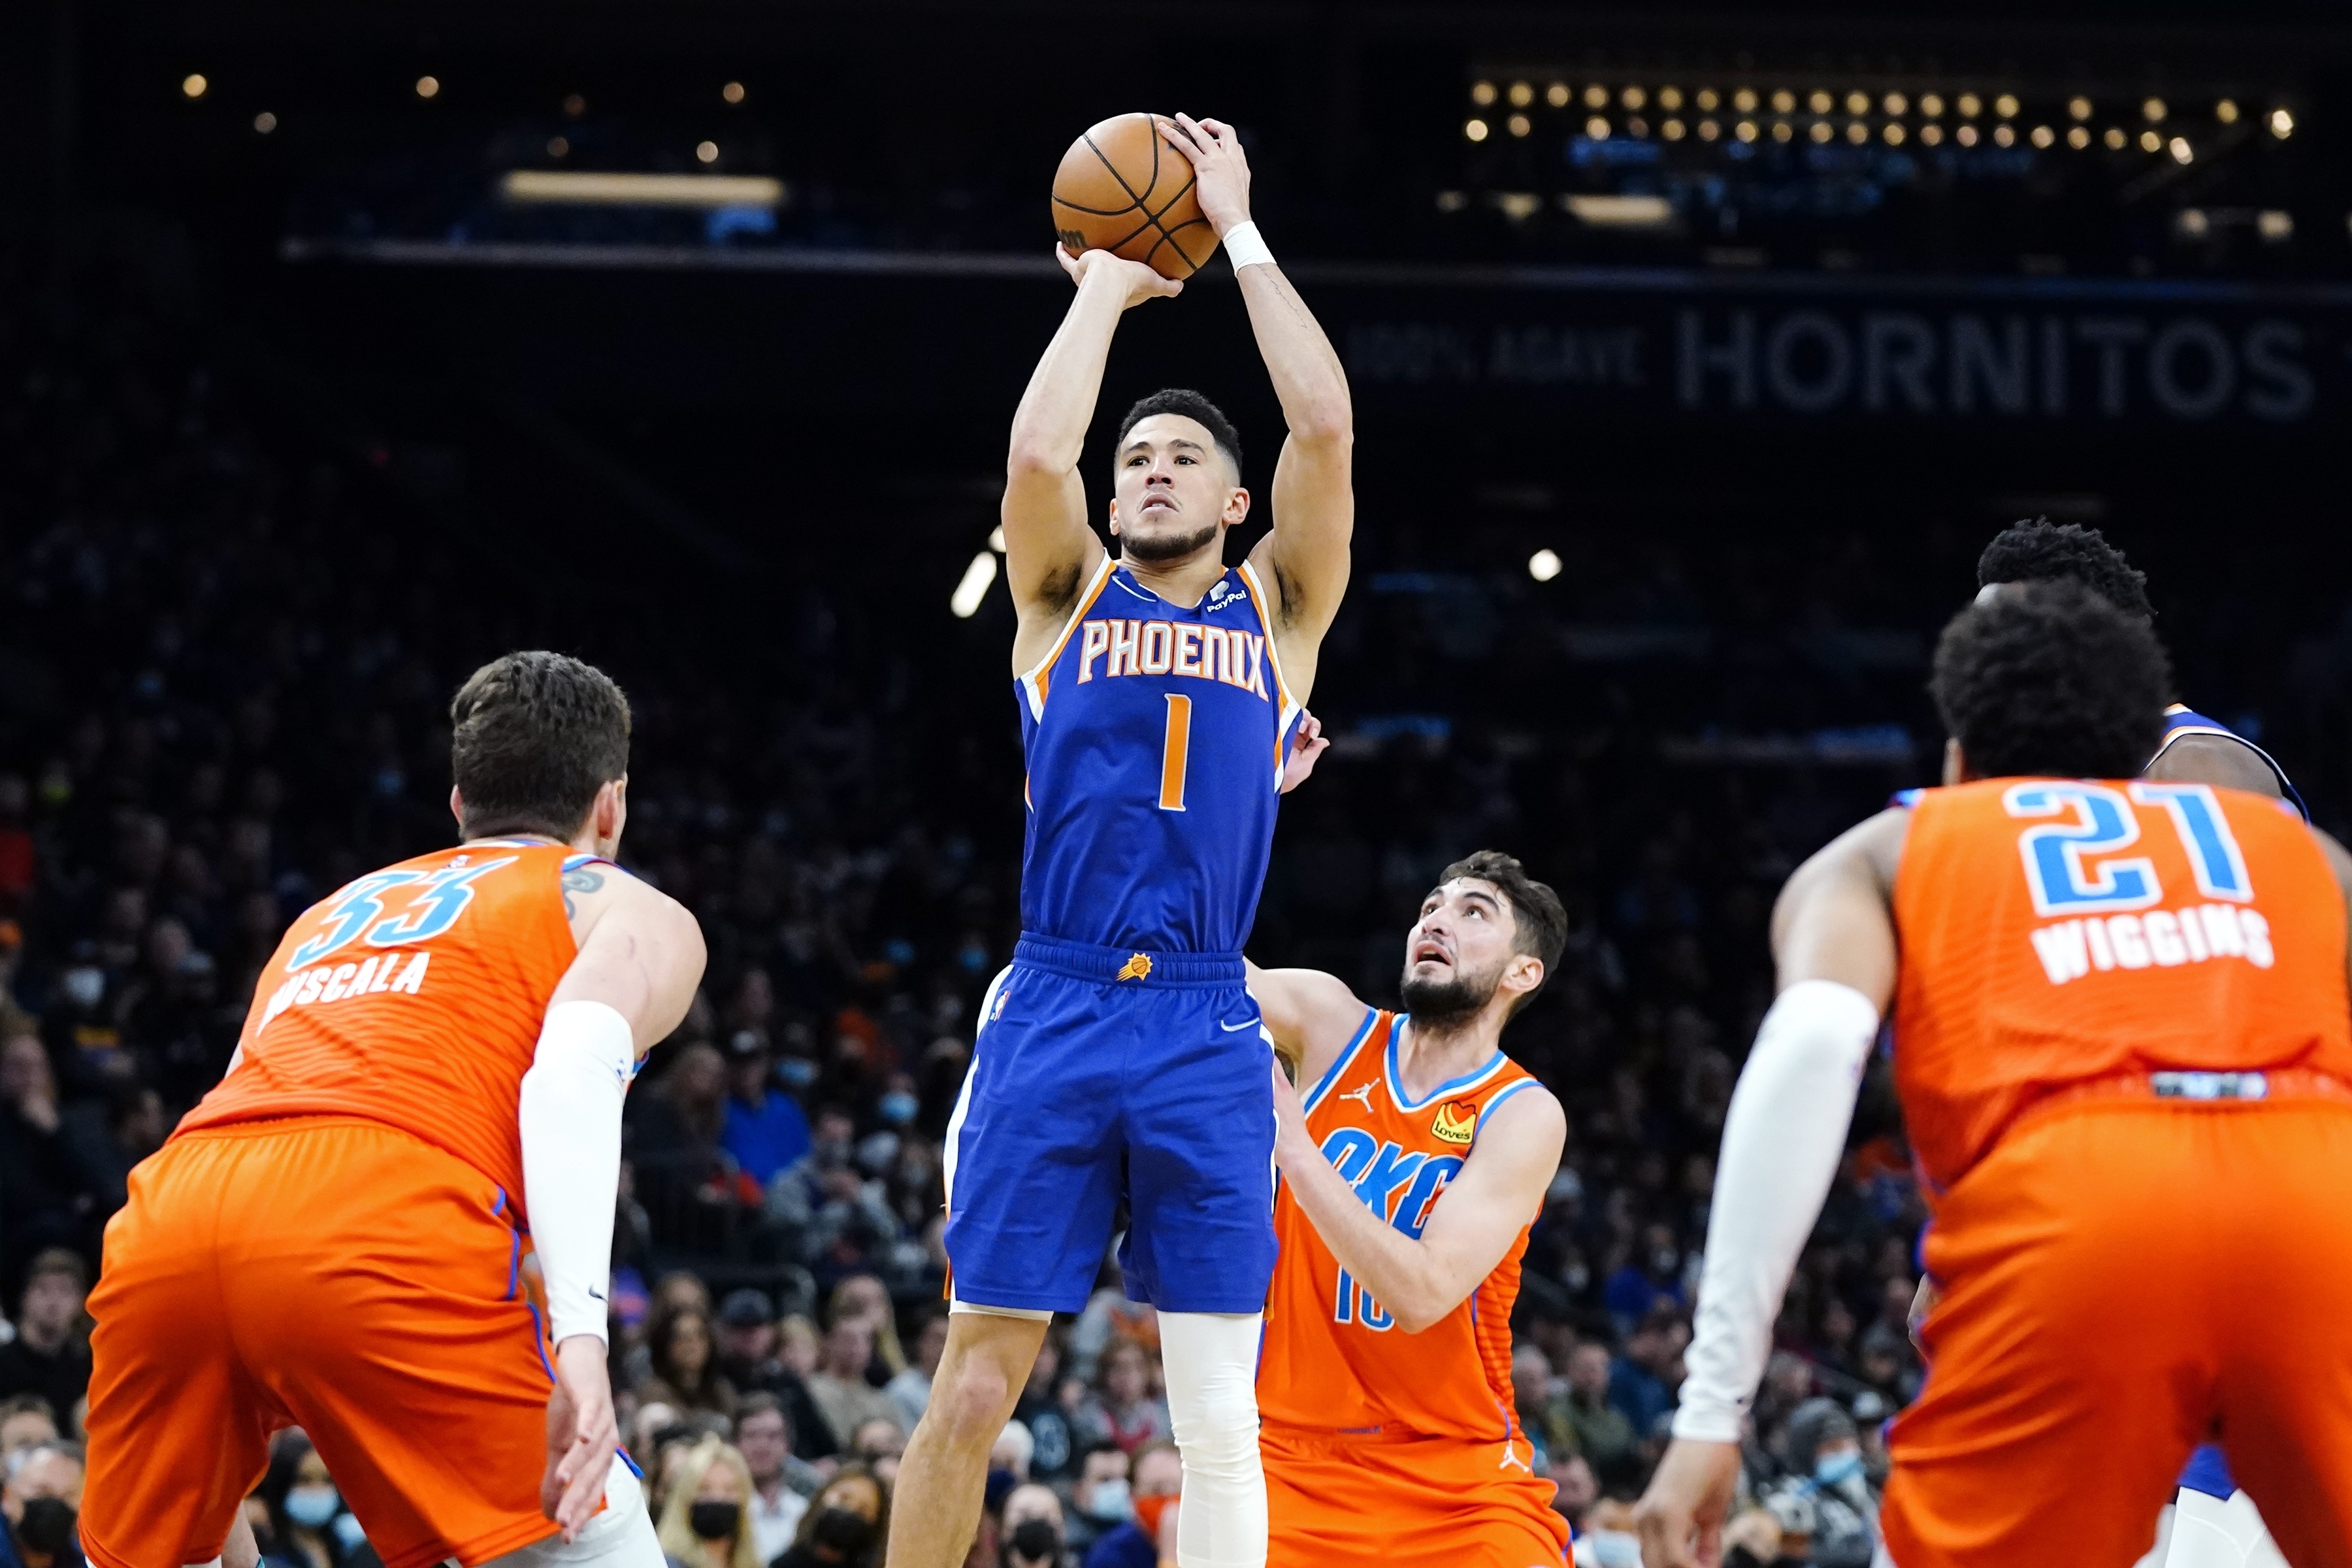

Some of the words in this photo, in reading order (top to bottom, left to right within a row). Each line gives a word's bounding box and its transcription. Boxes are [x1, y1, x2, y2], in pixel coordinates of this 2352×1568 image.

[1489, 323, 1646, 387] AGAVE
[1676, 310, 2315, 418] HORNITOS
[1207, 589, 1247, 613] PayPal
[1077, 619, 1269, 702] PHOENIX
[1158, 693, 1192, 811] 1
[2002, 781, 2255, 919] 21
[285, 855, 519, 972] 33
[2030, 903, 2276, 985] WIGGINS
